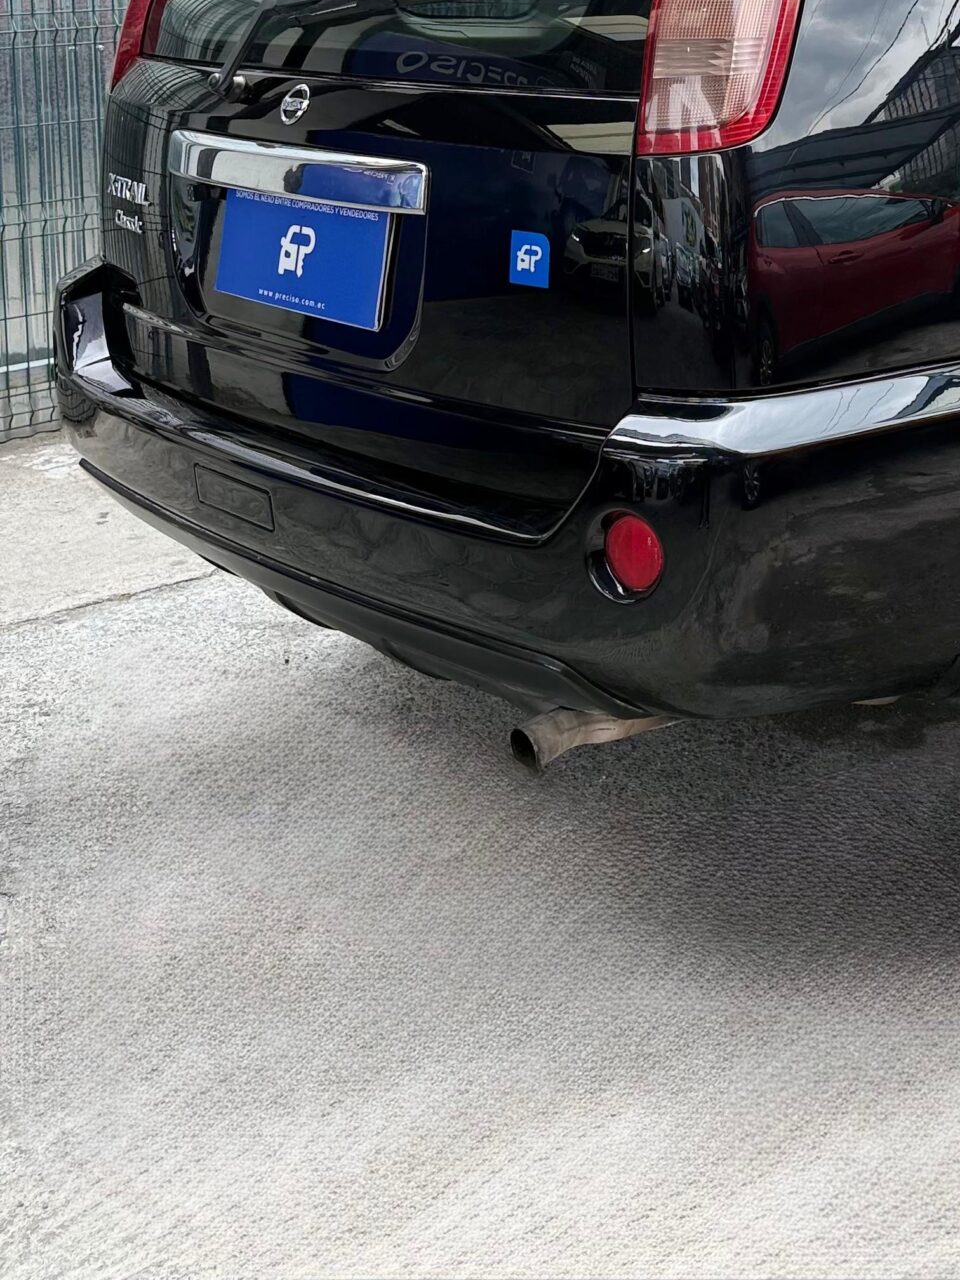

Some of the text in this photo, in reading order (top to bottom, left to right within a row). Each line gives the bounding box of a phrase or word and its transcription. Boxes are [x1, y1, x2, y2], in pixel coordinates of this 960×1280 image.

[236, 190, 254, 201] SOMOS
[254, 193, 261, 201] EL
[275, 196, 292, 207] ENTRE
[292, 199, 335, 215] COMPRADORES
[340, 207, 379, 221] VENDEDORES
[258, 288, 326, 310] www.preciso.com.ec
